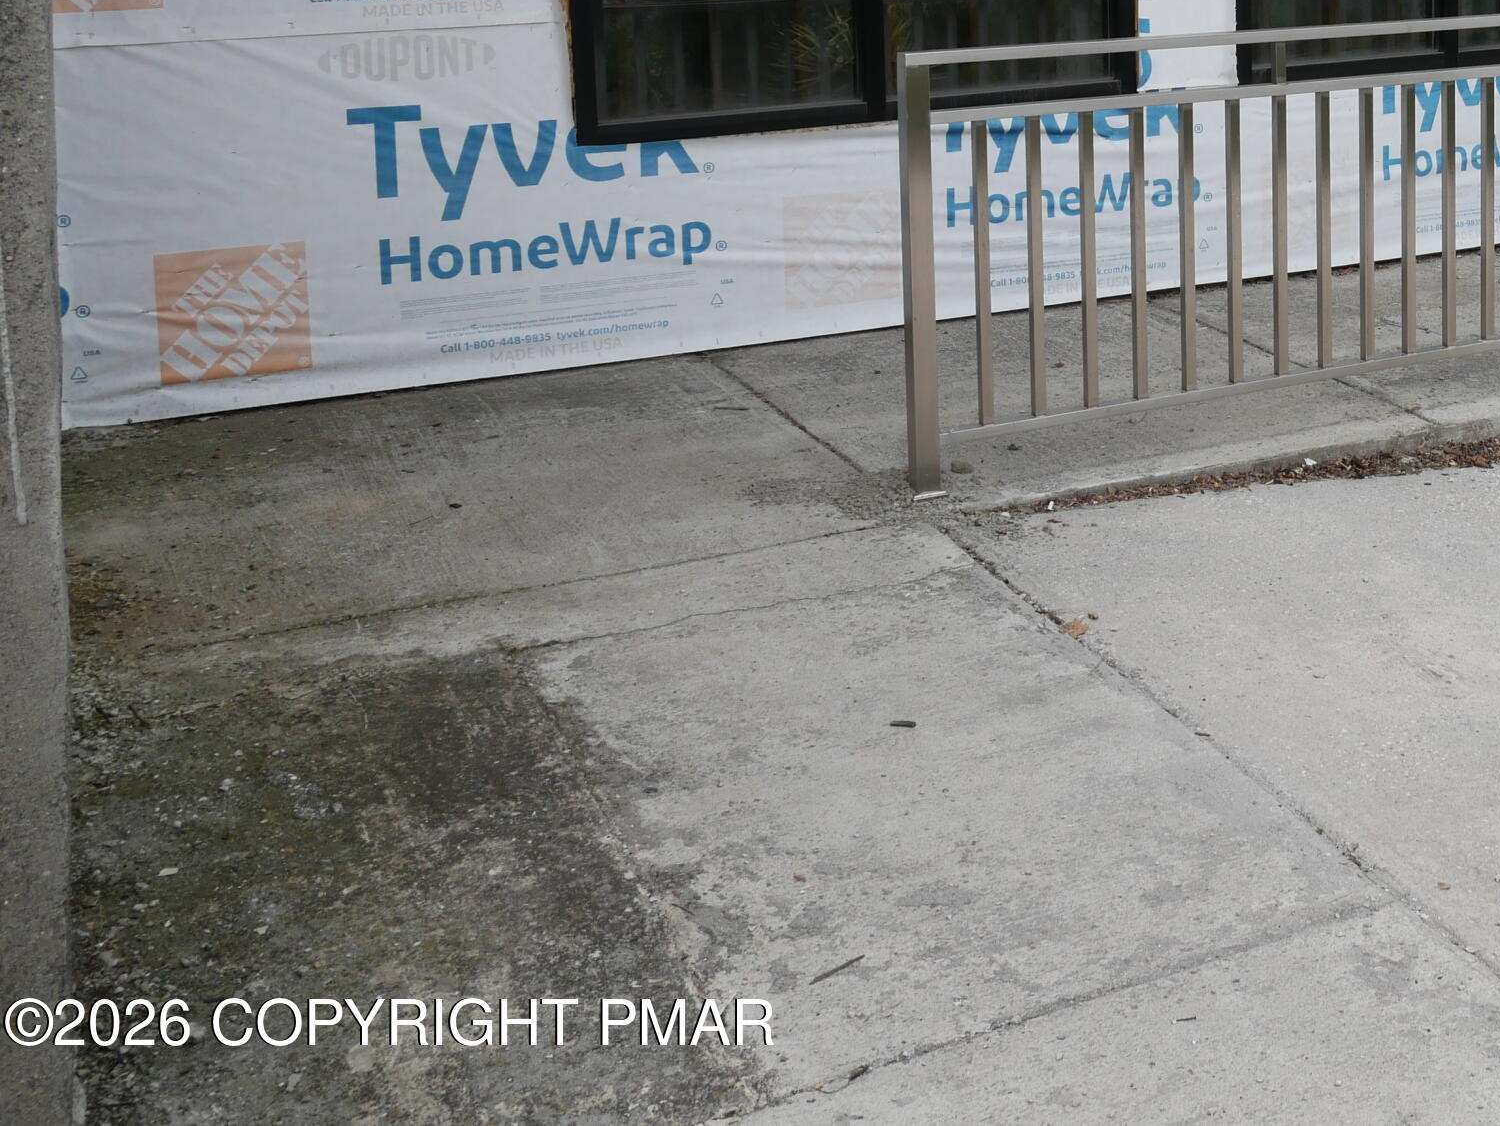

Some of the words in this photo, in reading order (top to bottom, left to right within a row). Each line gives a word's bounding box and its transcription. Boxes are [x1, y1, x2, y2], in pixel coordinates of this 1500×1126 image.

[362, 4, 412, 18] MADE
[417, 3, 432, 17] IN
[437, 1, 468, 15] THE
[473, 0, 504, 13] USA
[340, 35, 478, 82] DUPONT
[171, 262, 235, 317] THE
[991, 278, 1006, 287] Call
[160, 243, 306, 382] HOME
[219, 290, 310, 376] DEPOT
[440, 343, 461, 354] Call
[463, 333, 551, 351] 1-800-448-9835
[556, 320, 670, 341] tyvek.com/homewrap
[489, 349, 535, 364] MADE
[540, 346, 555, 359] IN
[561, 341, 589, 356] THE
[594, 337, 623, 352] USA
